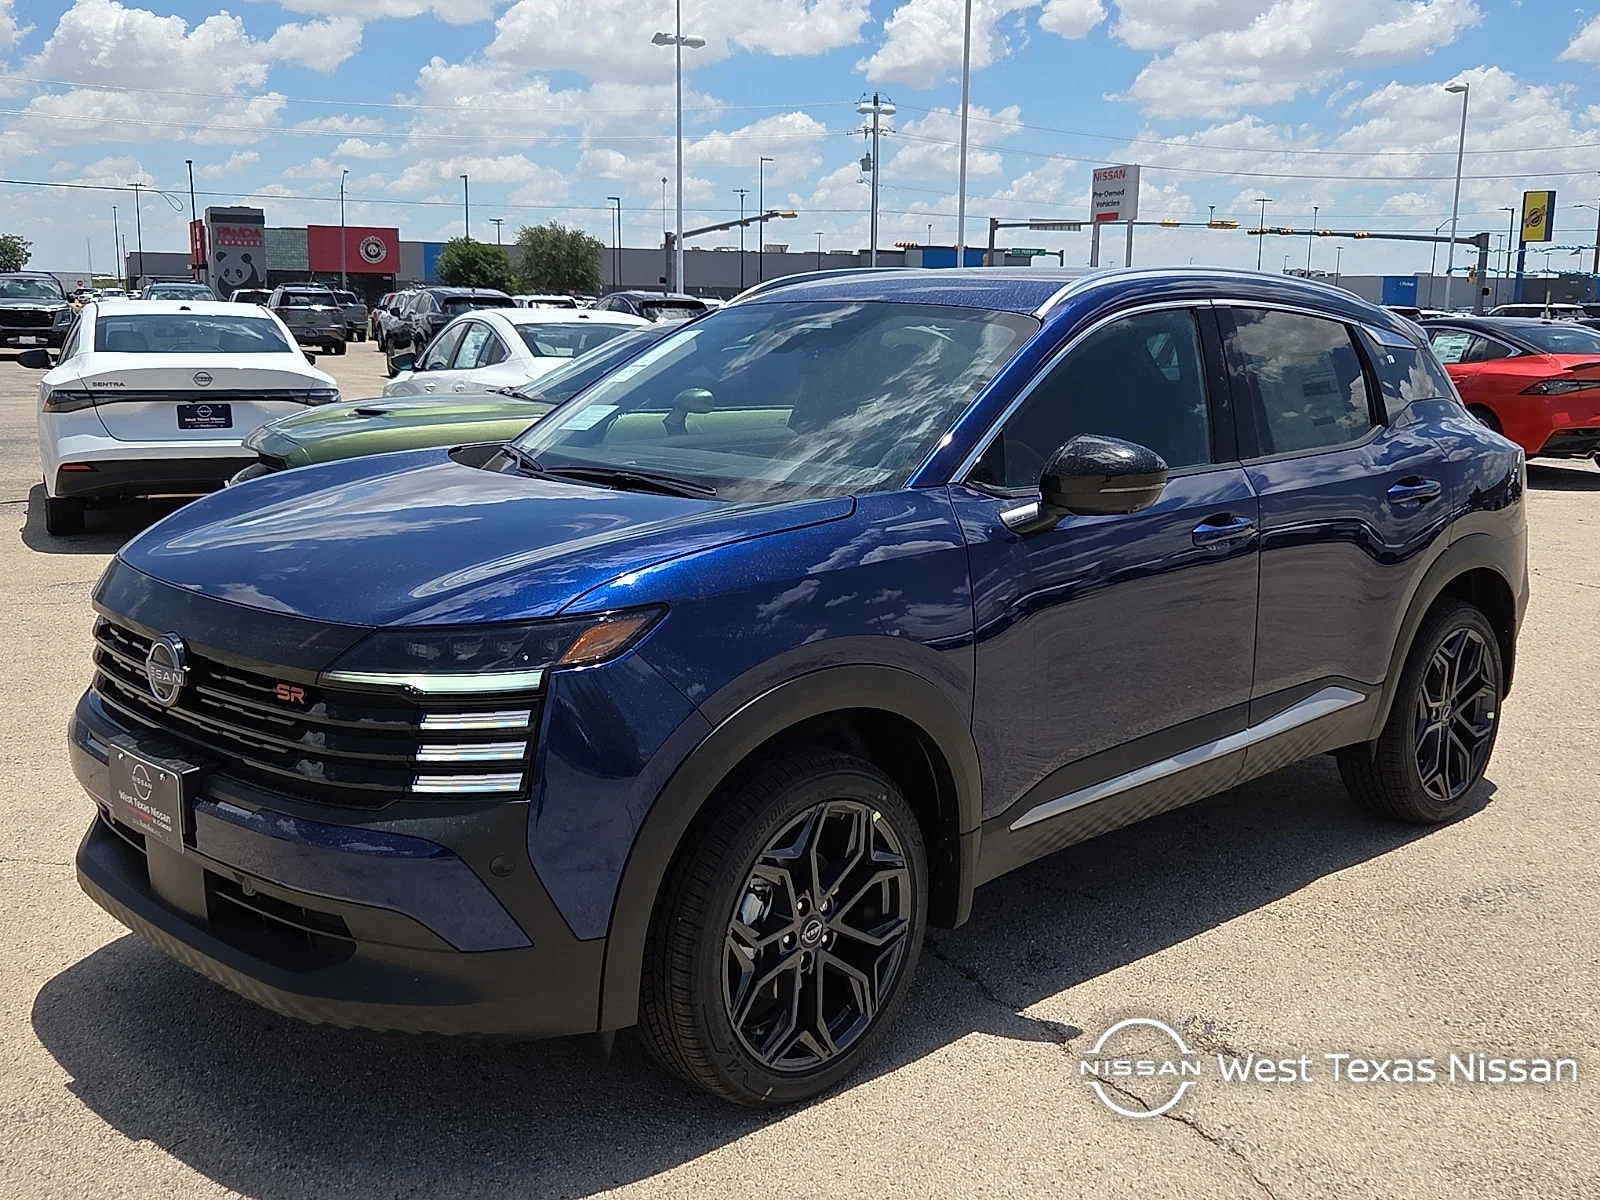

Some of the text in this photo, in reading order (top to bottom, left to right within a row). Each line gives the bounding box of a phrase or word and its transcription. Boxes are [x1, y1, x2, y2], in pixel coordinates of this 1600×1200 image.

[1094, 169, 1126, 182] NISSAN
[1093, 188, 1125, 199] Pre-Owned
[1096, 200, 1120, 208] Vehicles
[149, 664, 182, 684] SSAN
[277, 684, 305, 705] SR
[133, 797, 150, 814] Texas
[150, 806, 172, 826] Nissan
